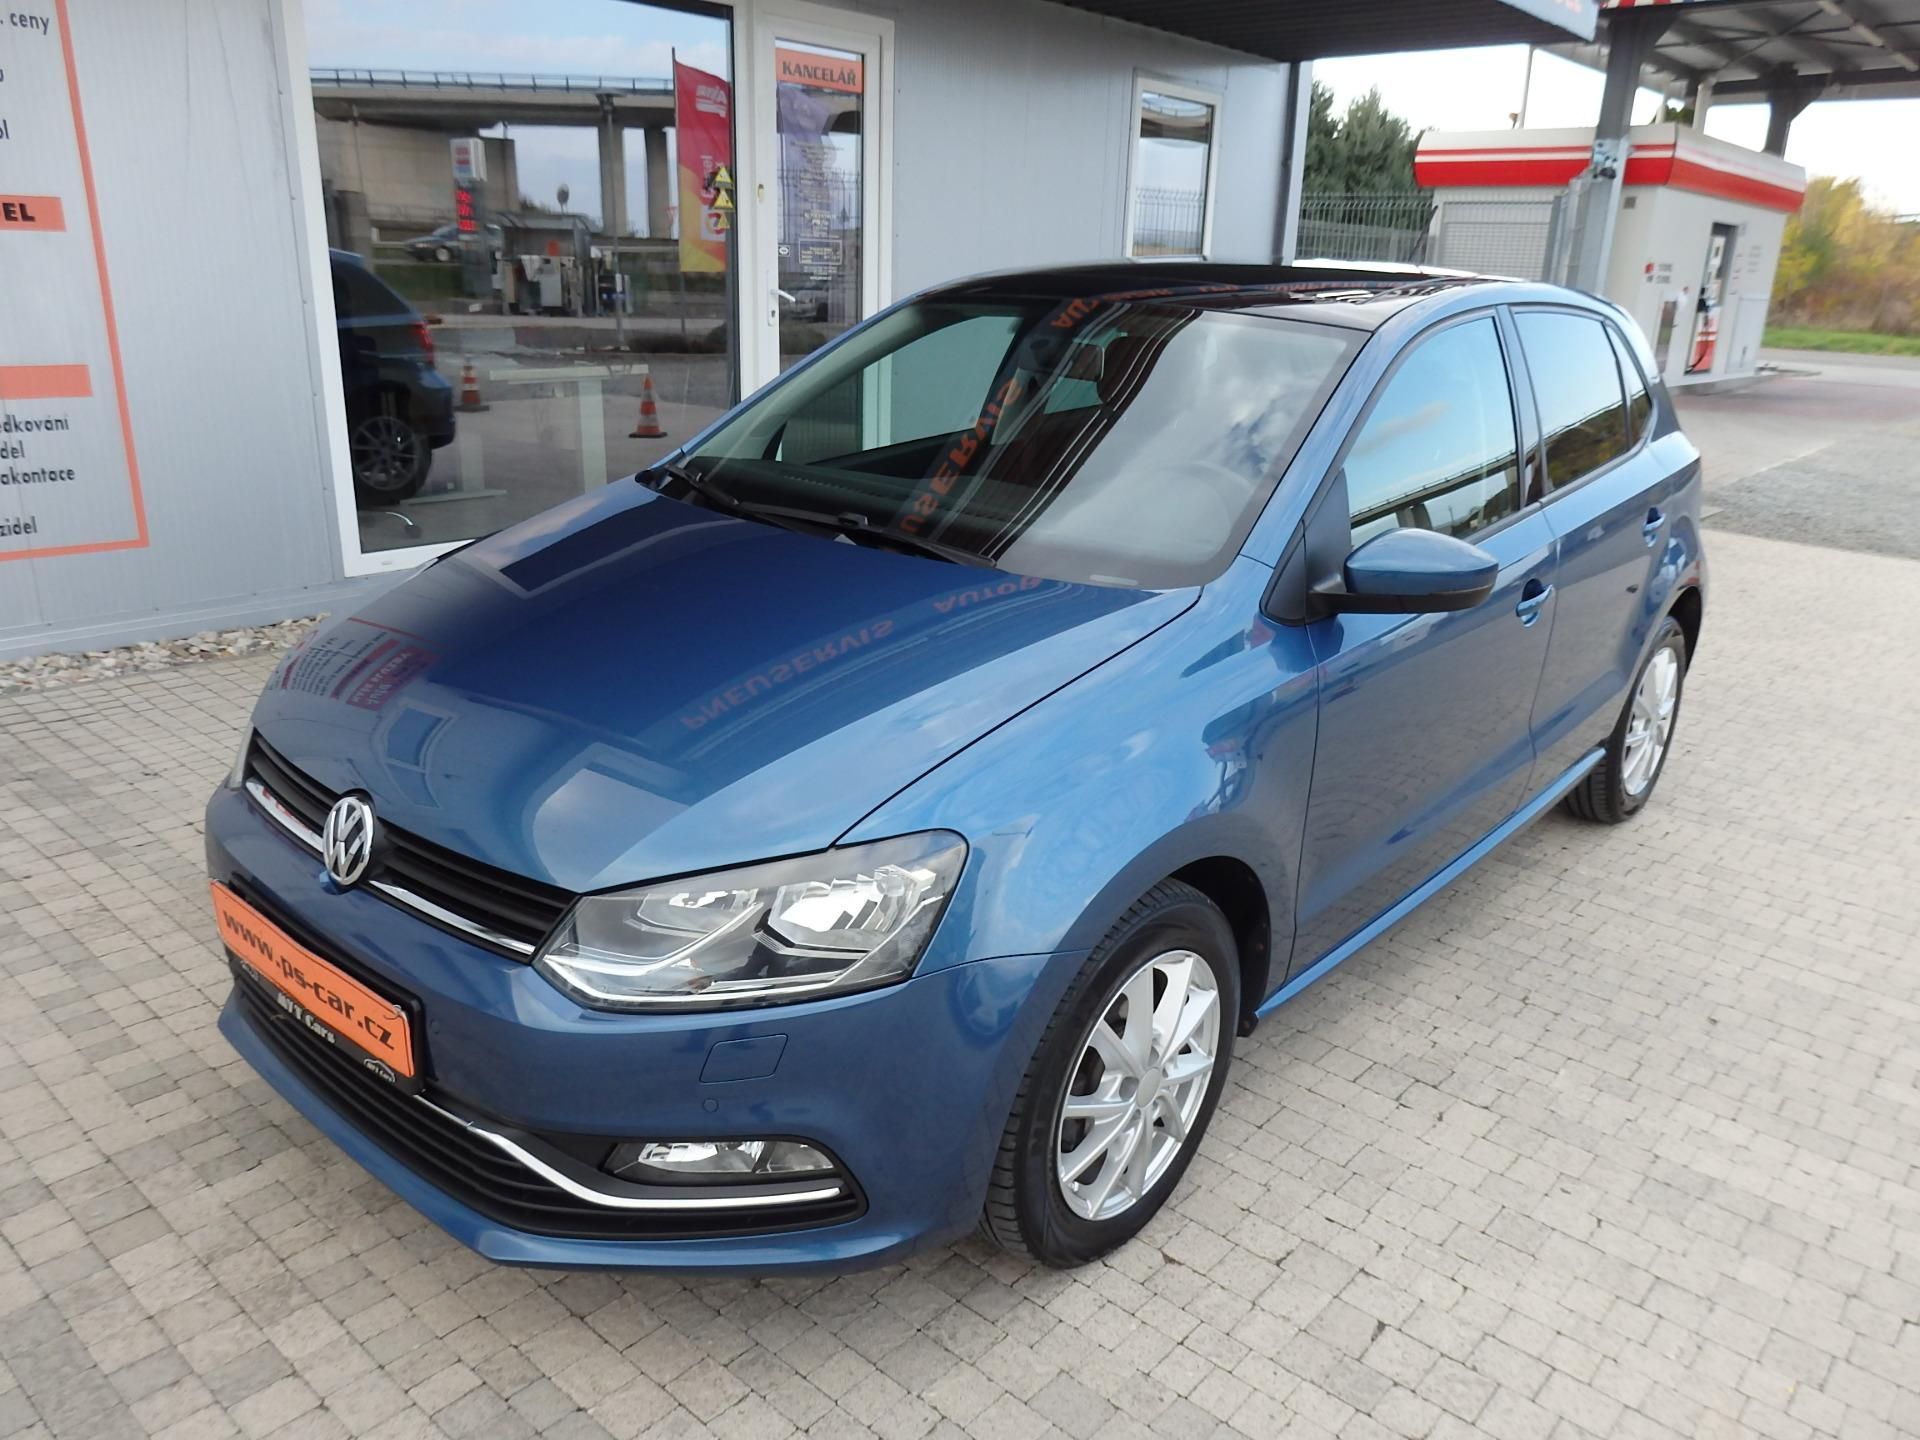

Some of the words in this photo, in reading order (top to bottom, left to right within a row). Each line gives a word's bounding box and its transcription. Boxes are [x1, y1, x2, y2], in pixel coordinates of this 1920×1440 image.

[10, 12, 50, 35] ceny
[0, 440, 25, 460] del
[0, 466, 75, 486] akontace
[222, 909, 396, 1051] www.ps-car.cz
